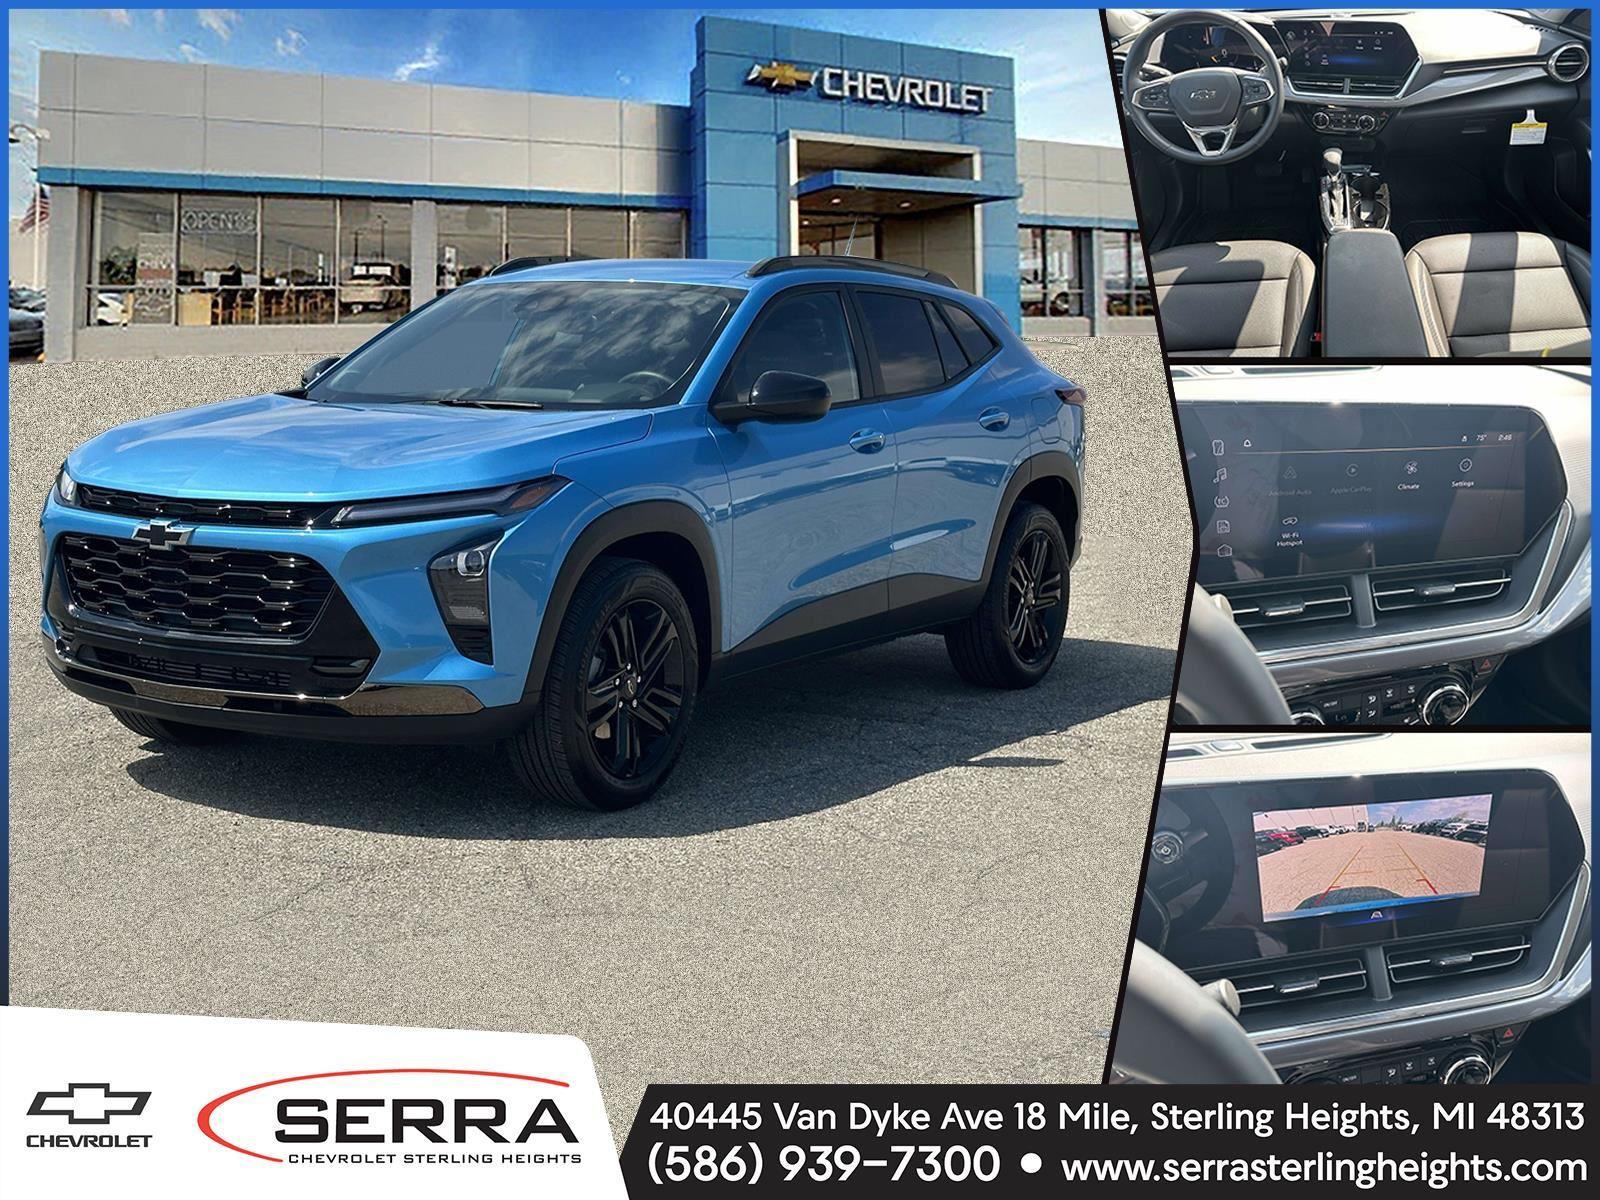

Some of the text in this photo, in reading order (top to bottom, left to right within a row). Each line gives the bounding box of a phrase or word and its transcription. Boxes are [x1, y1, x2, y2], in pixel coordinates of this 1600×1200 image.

[822, 67, 993, 113] CHEVROLET
[1451, 480, 1475, 488] Settings
[1276, 539, 1303, 548] Hotspot
